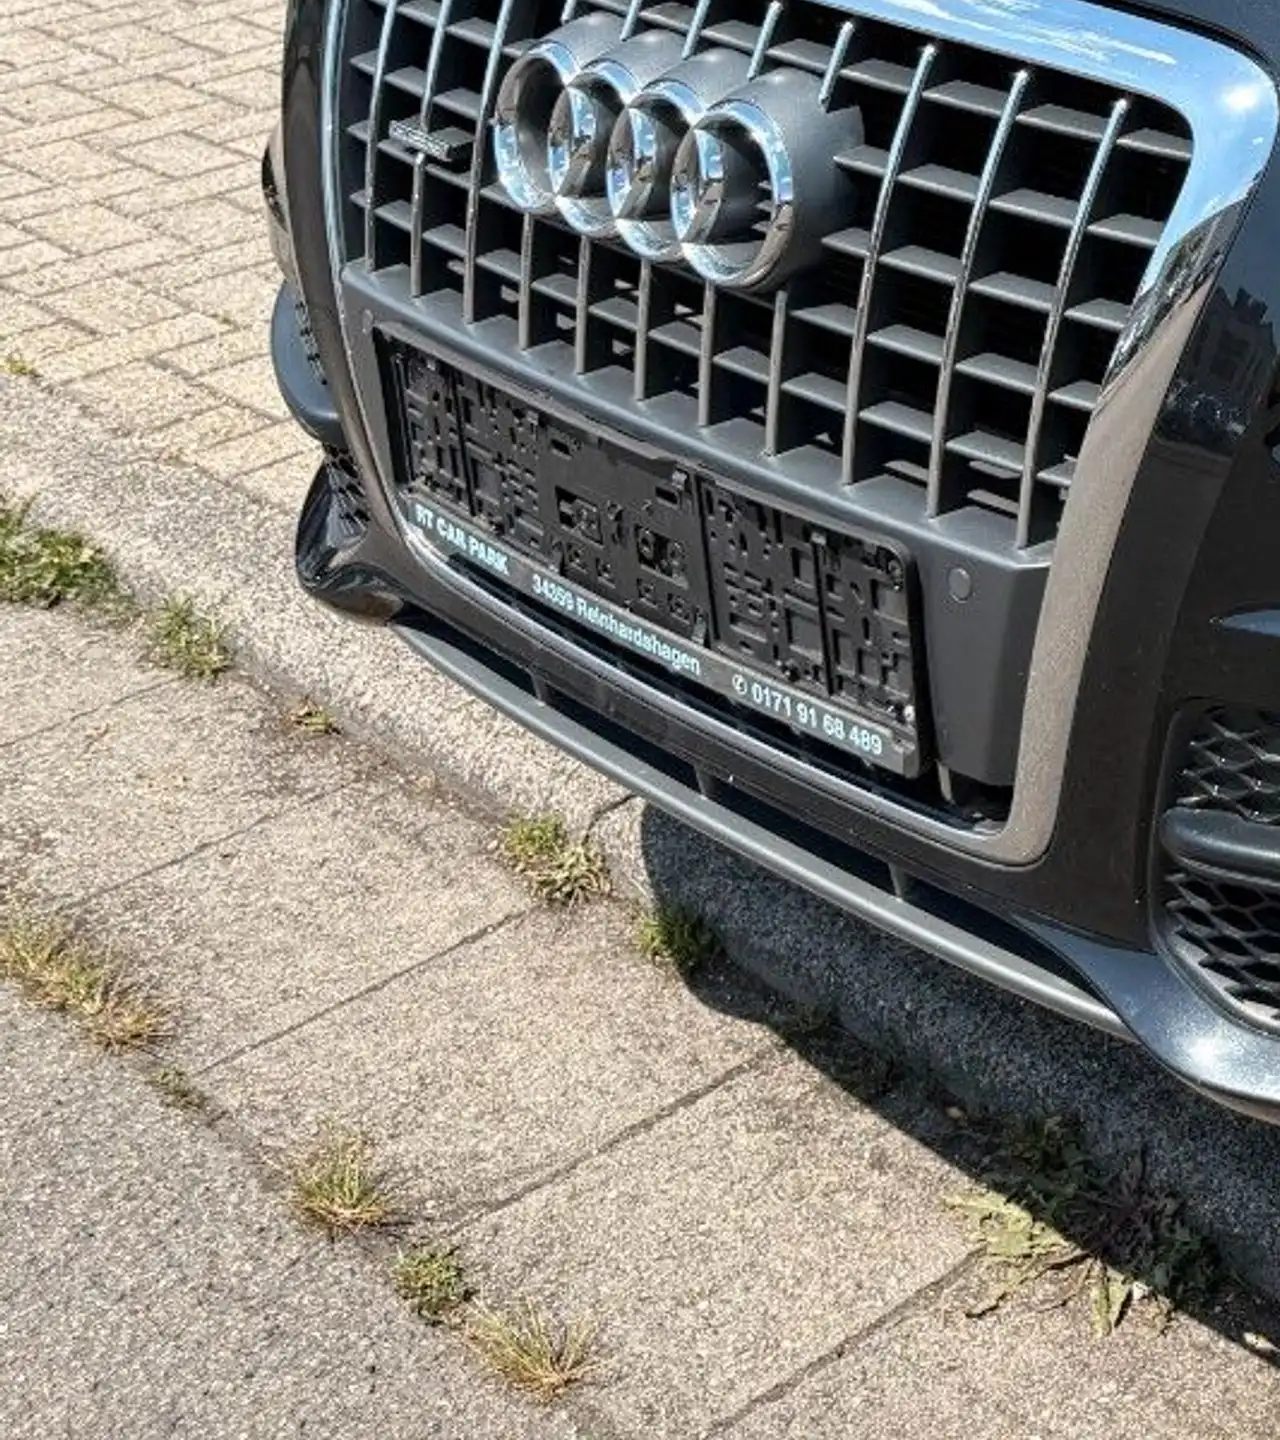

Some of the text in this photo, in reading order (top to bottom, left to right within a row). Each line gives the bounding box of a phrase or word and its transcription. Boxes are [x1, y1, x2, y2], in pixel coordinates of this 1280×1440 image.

[436, 517, 467, 551] CAR
[468, 535, 509, 576] PARK
[575, 597, 702, 676] Reinhardshagen
[751, 683, 883, 755] 0171 91 68 489
